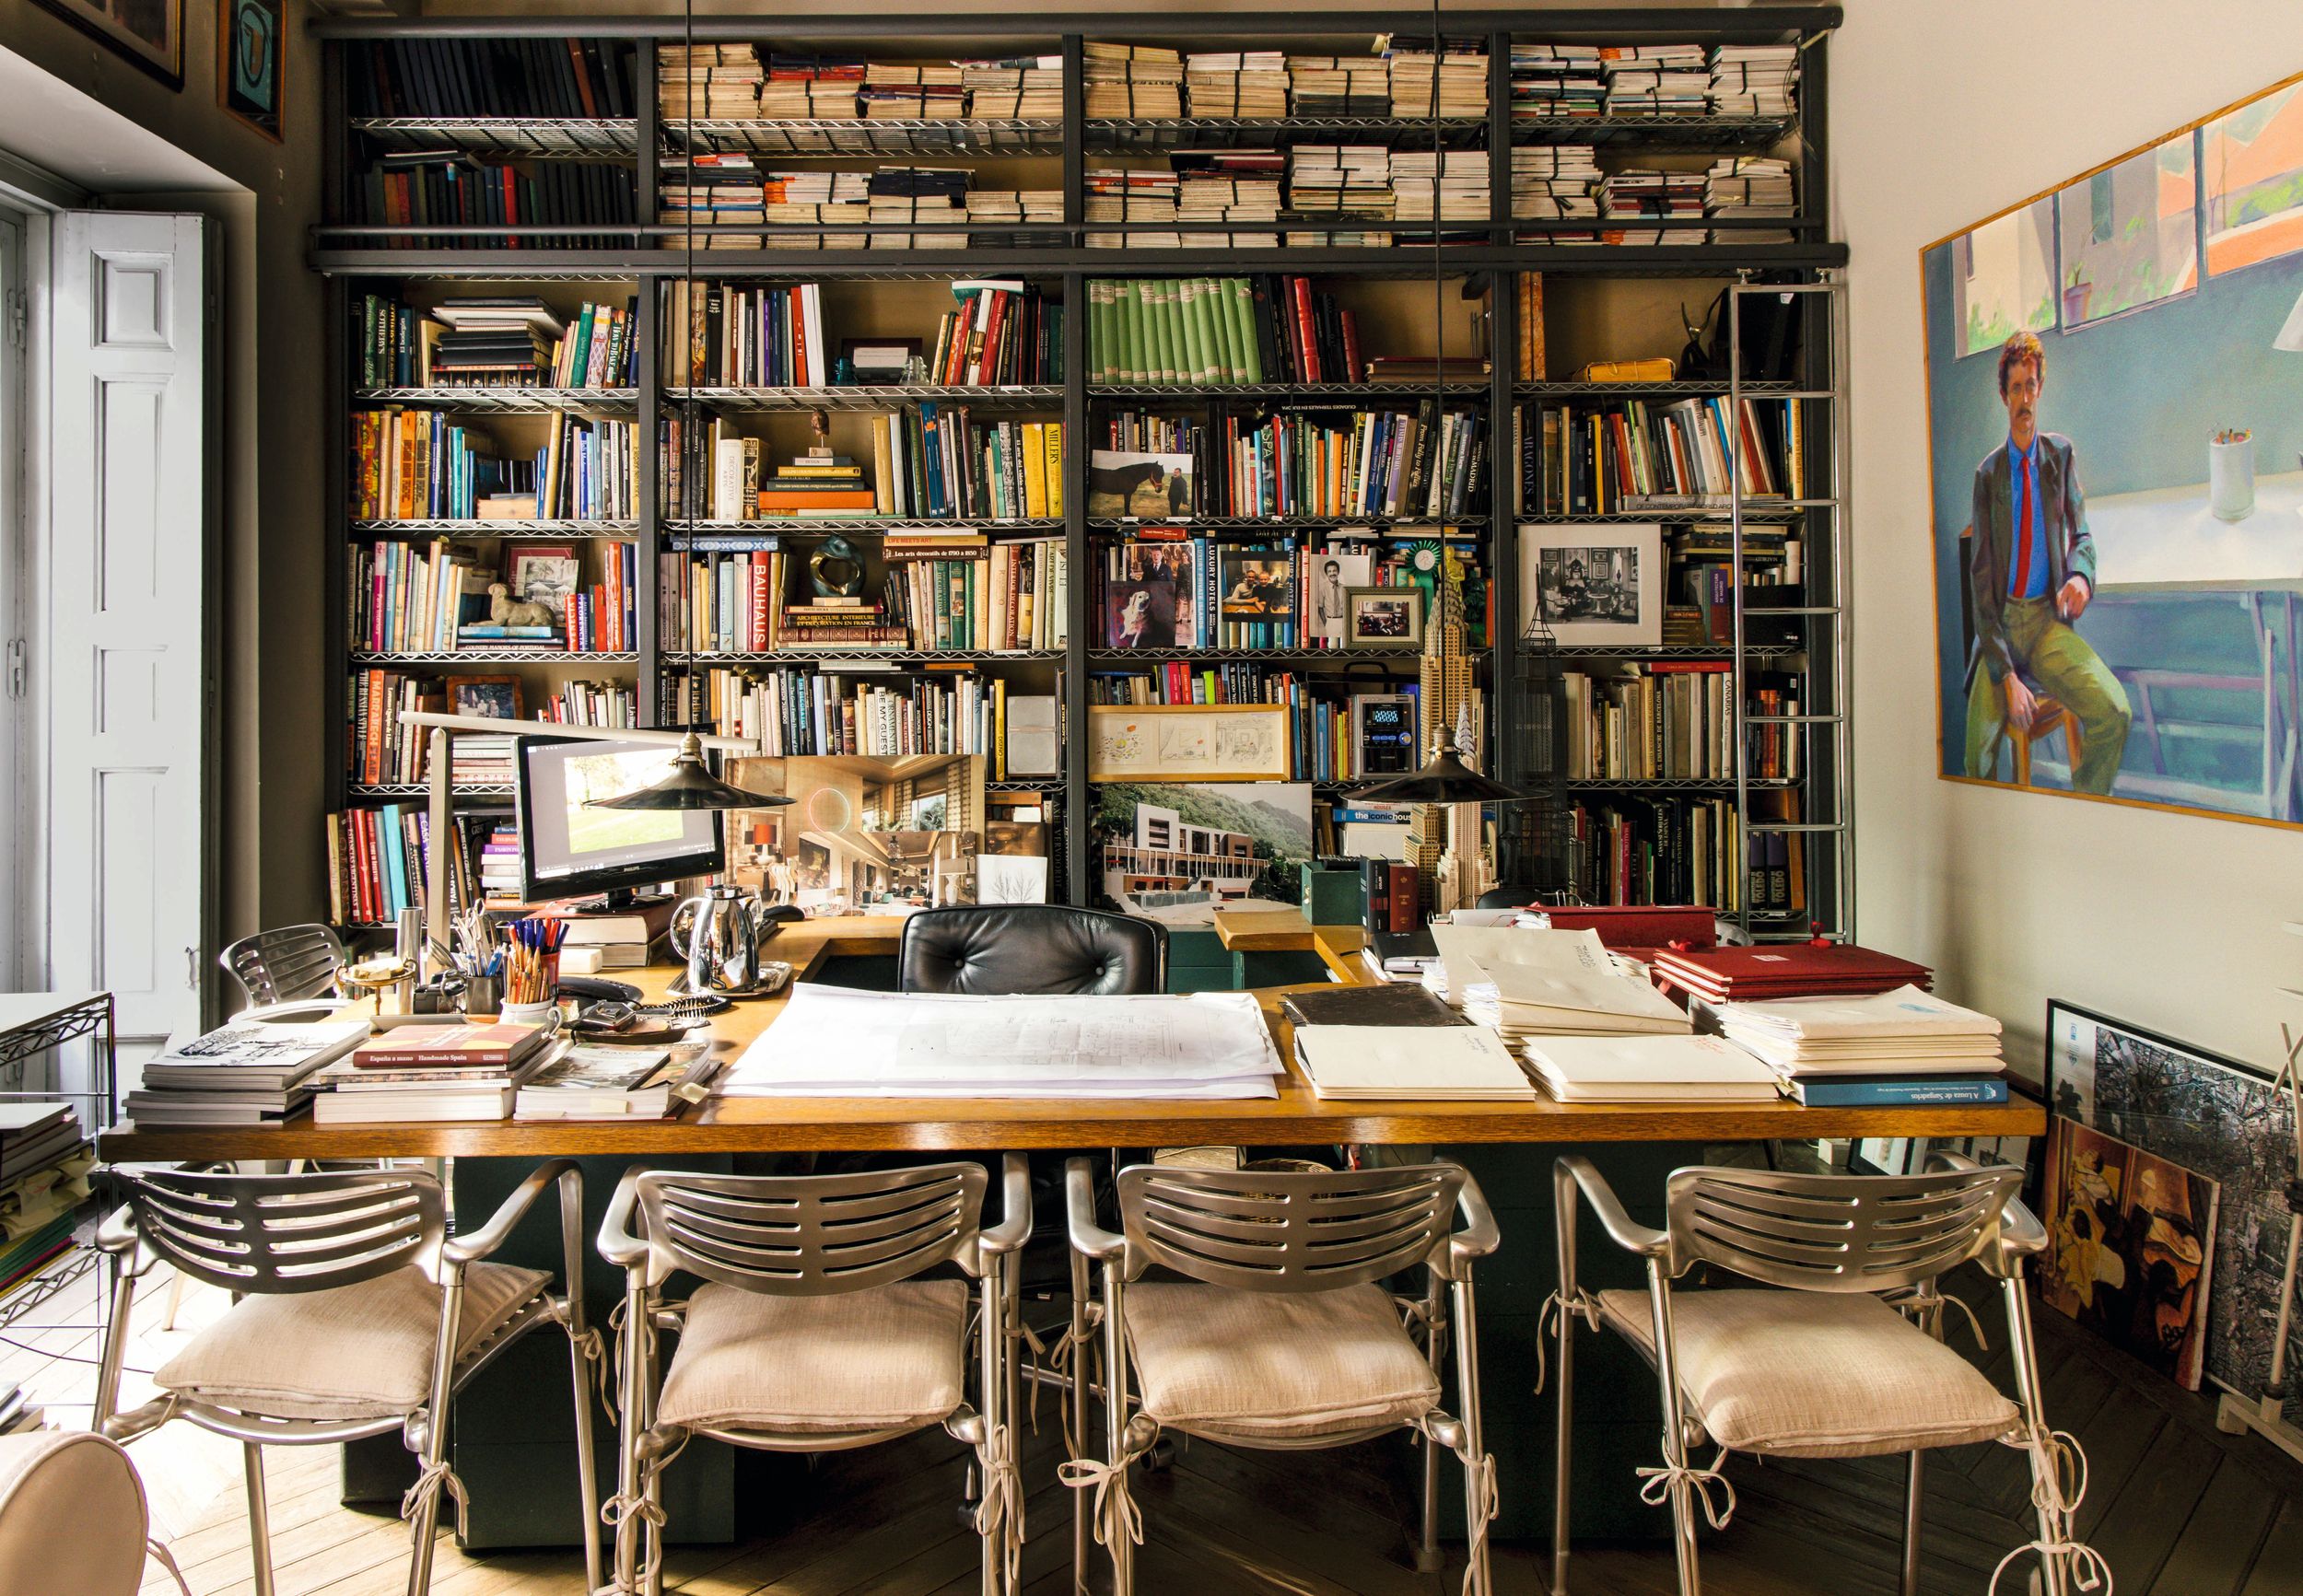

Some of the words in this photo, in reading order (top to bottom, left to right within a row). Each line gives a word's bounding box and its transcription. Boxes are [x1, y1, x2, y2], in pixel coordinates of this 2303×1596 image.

[1419, 424, 1427, 442] From
[1049, 430, 1059, 464] MILLER'S
[1263, 433, 1273, 458] SPA
[1415, 442, 1425, 459] Folly
[1412, 467, 1422, 487] Follies
[1468, 461, 1477, 492] MADRID
[754, 565, 766, 643] BAUHAUS
[879, 691, 885, 703] BE
[370, 681, 381, 745] MARRAKECH
[880, 706, 886, 721] MY
[1657, 726, 1661, 734] DE
[1756, 871, 1765, 902] TOLEDO
[1775, 871, 1785, 902] TOLEDO
[1911, 1092, 1943, 1100] Sargadelos
